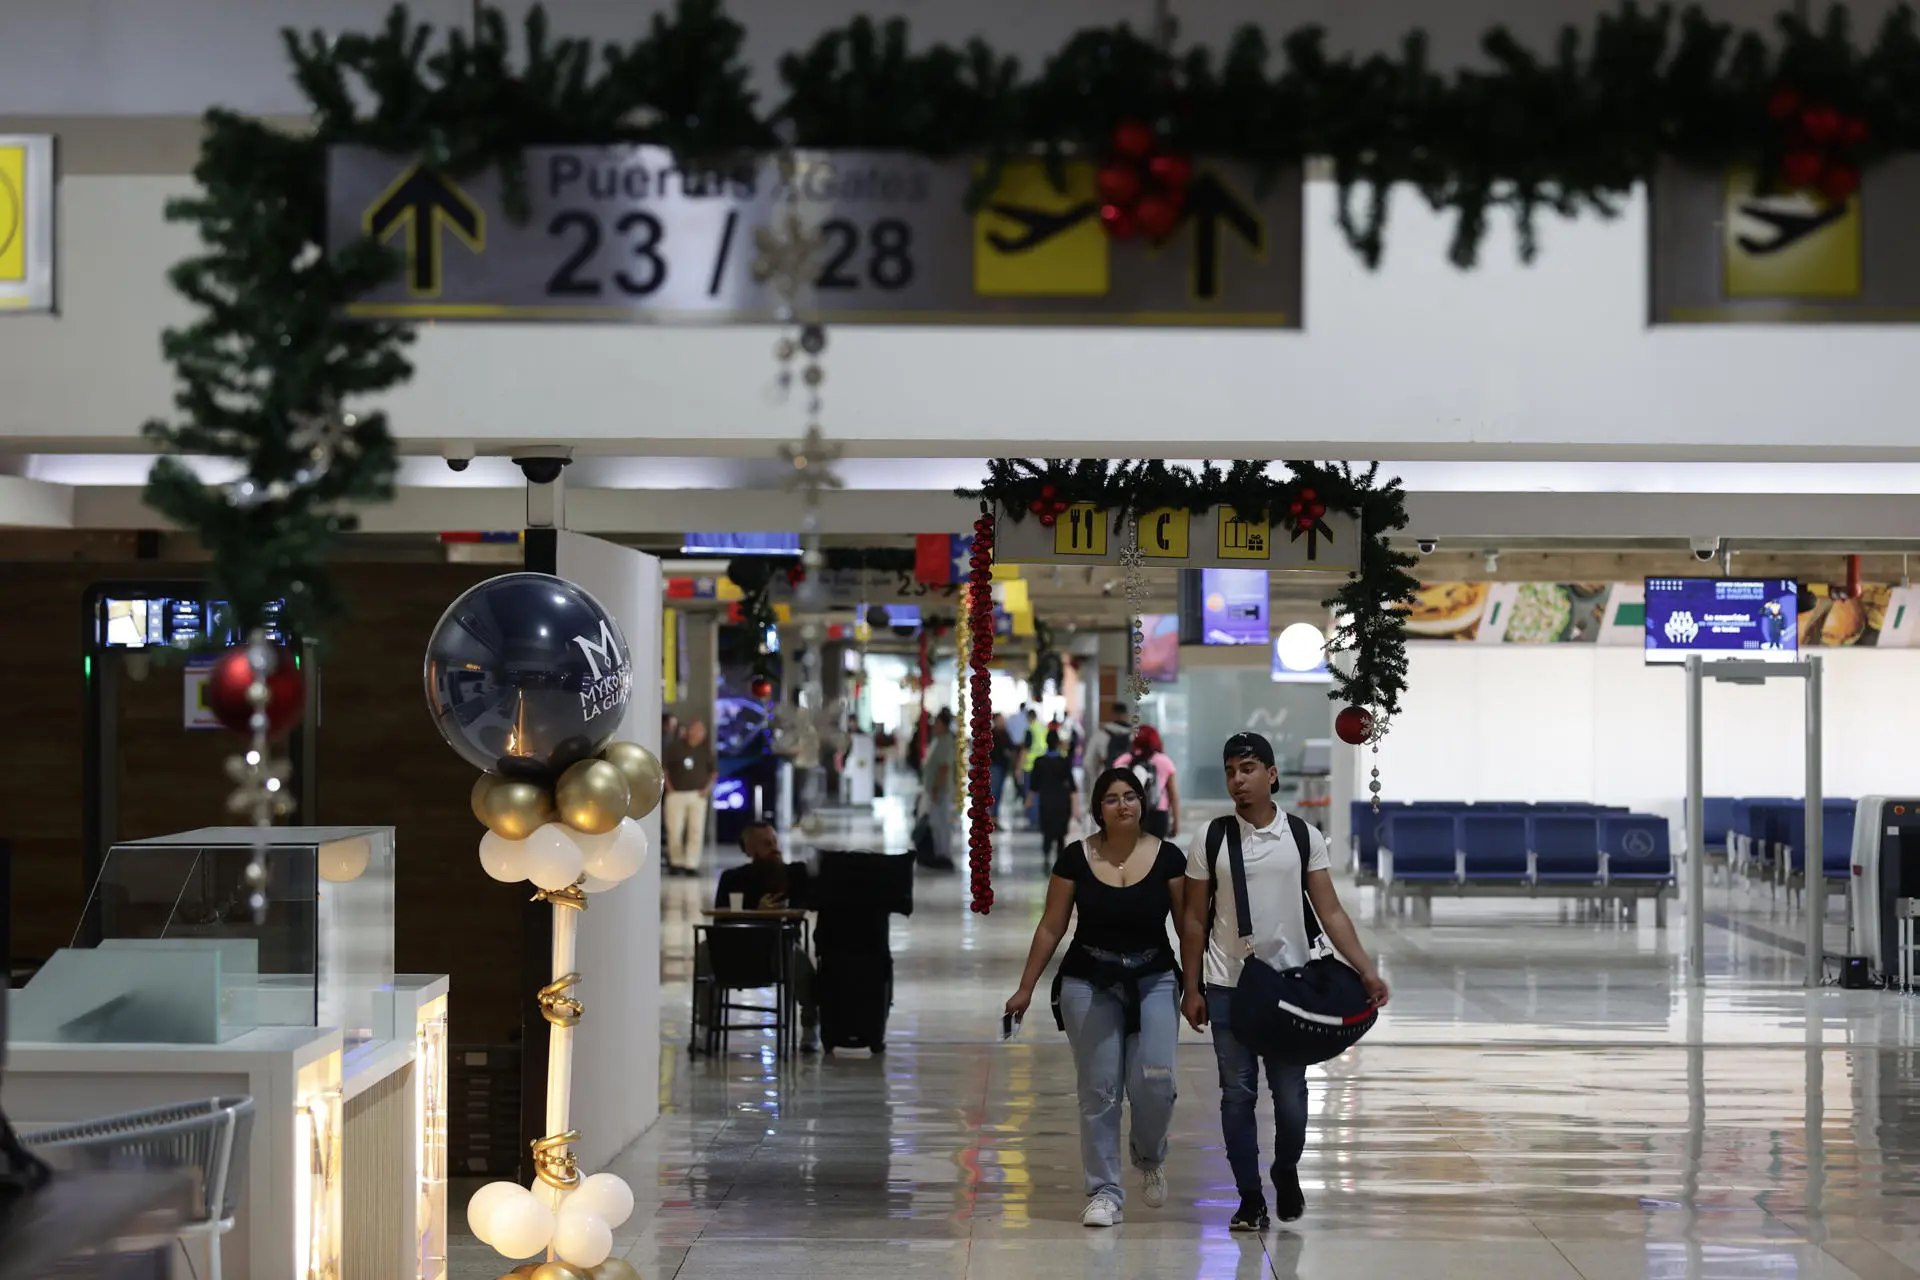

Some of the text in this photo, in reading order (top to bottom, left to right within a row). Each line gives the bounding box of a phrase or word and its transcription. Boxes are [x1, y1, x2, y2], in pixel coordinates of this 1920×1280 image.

[548, 155, 756, 202] Puer
[546, 210, 914, 297] 23 / 28
[579, 669, 633, 708] MYKON
